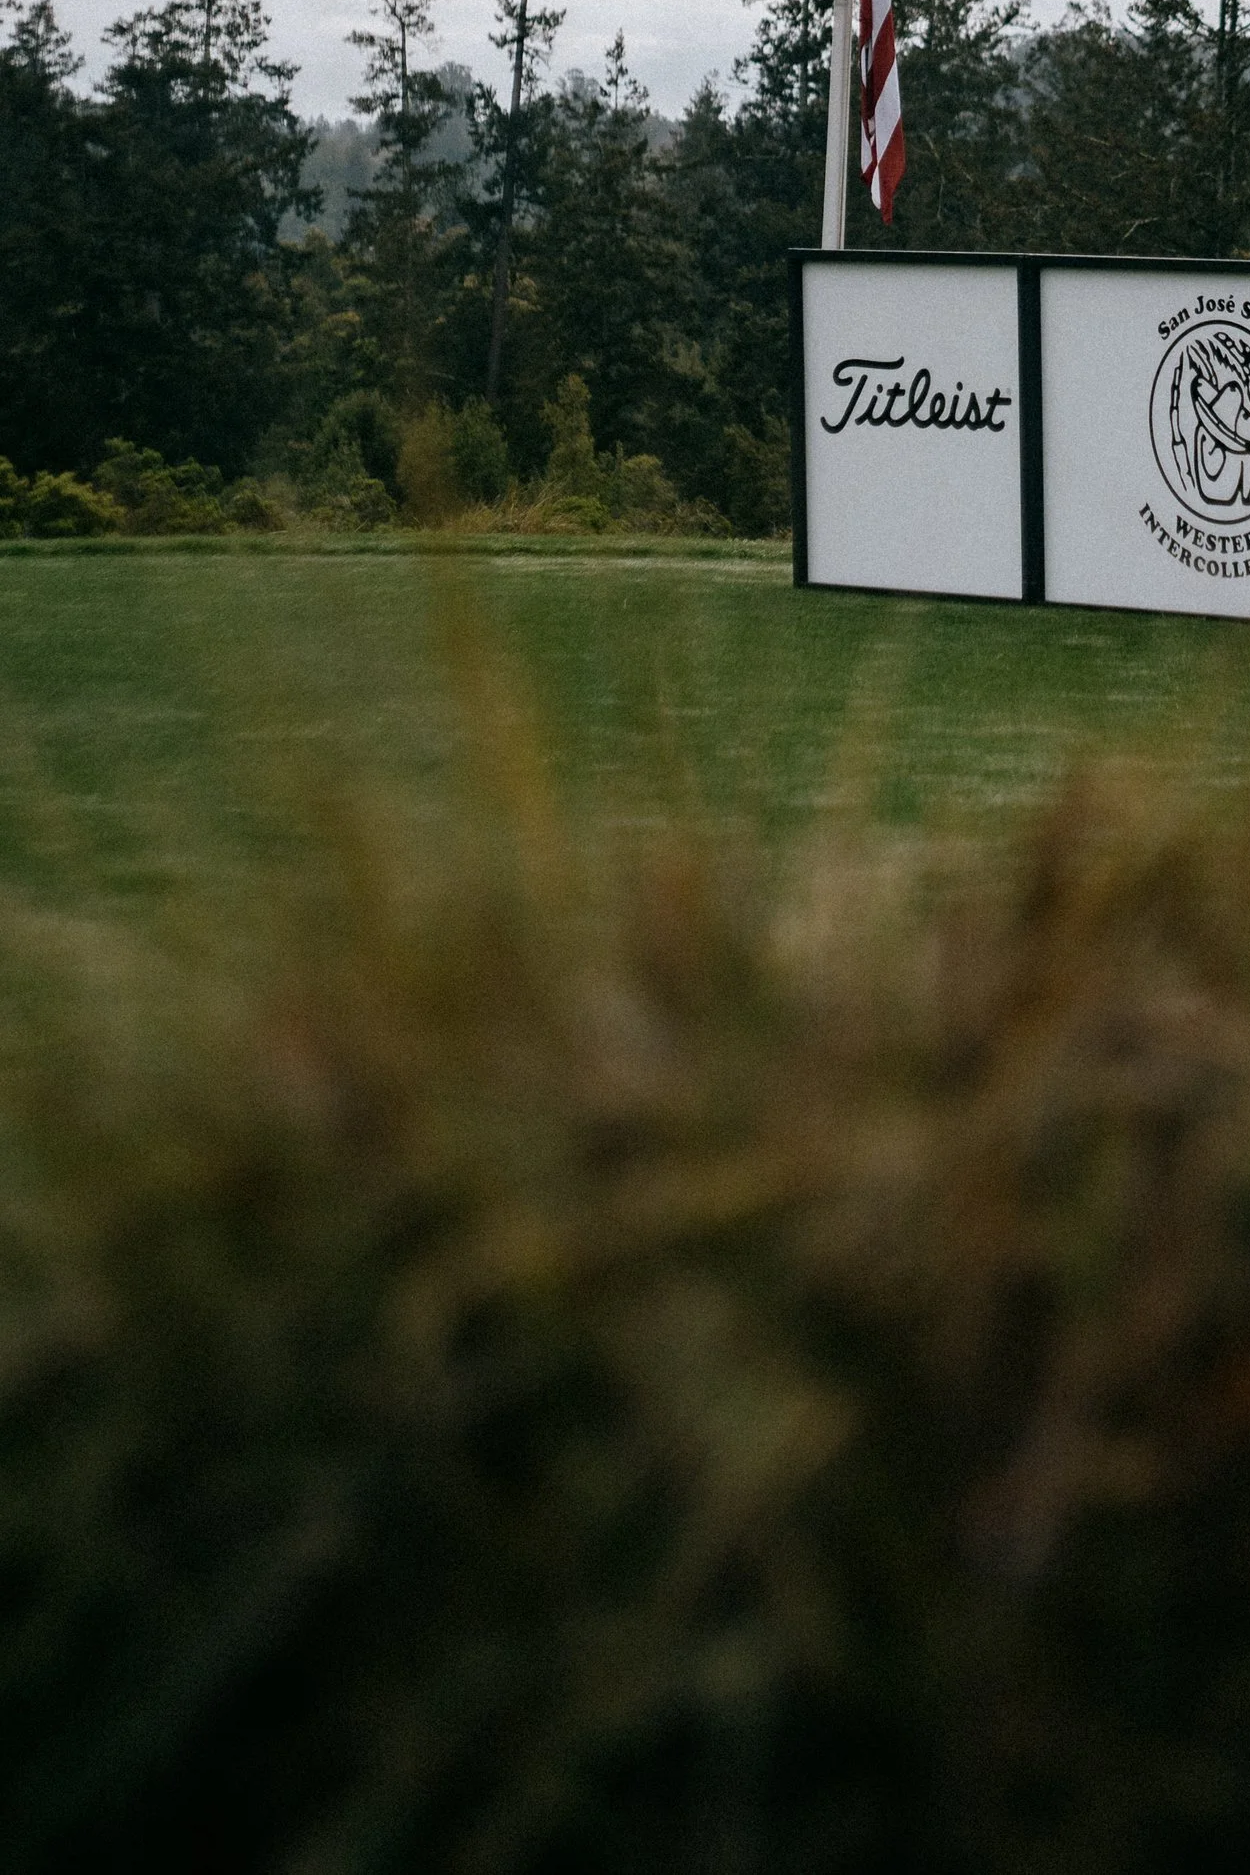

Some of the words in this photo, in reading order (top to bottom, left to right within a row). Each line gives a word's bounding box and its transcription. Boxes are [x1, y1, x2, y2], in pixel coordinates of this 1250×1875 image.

[1157, 307, 1191, 341] San
[1194, 294, 1236, 315] José
[820, 356, 1012, 434] Titleist
